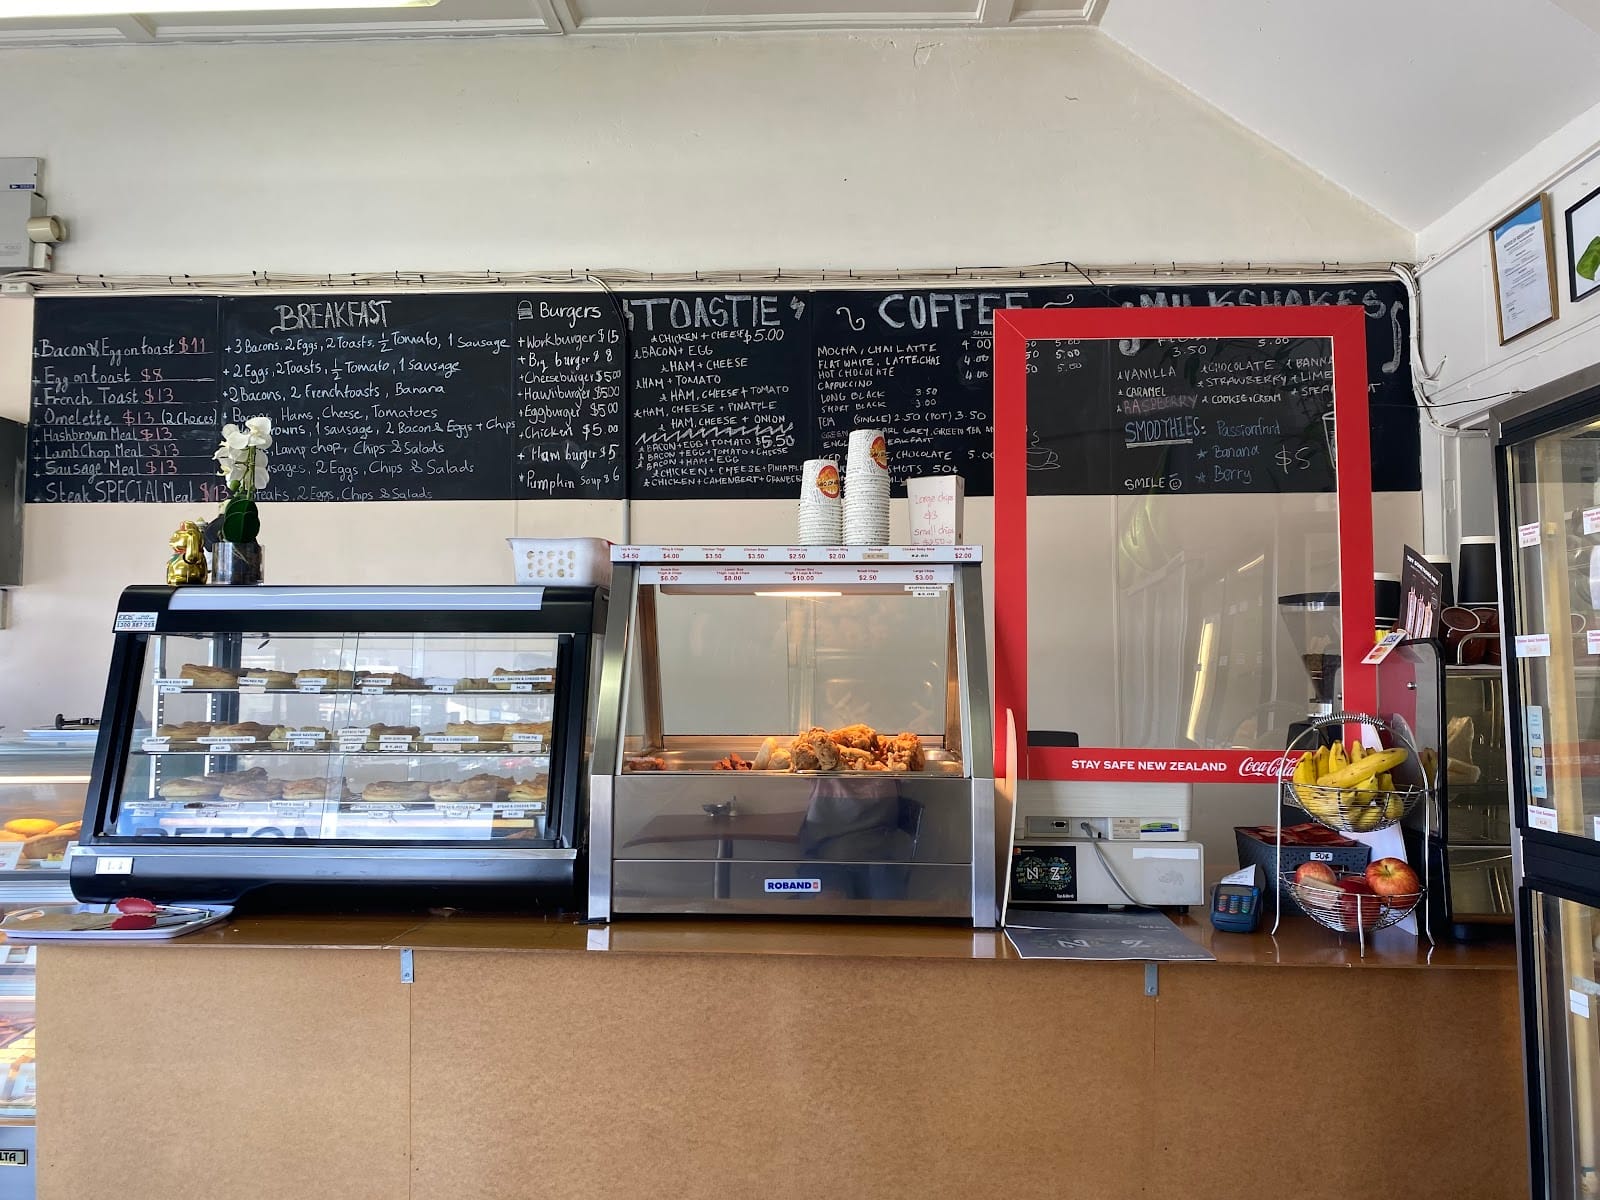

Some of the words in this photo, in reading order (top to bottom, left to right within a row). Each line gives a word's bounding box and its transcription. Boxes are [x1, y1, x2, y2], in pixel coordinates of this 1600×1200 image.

[270, 300, 391, 334] BREAKFAST
[540, 301, 601, 328] Burgers
[630, 294, 781, 331] TOASTIE
[234, 339, 242, 353] 3
[285, 338, 295, 350] 2
[326, 338, 335, 348] 2
[658, 332, 698, 344] CHICKEN
[102, 337, 121, 366] Egg
[179, 336, 206, 354] $11
[688, 345, 713, 356] EGG
[555, 351, 590, 370] burger
[670, 360, 695, 373] HAM
[706, 357, 749, 370] CHEESE
[818, 359, 841, 369] FLAT
[233, 364, 243, 377] 2
[818, 370, 835, 379] HOT
[1124, 366, 1176, 381] VANILLA
[44, 366, 68, 392] Egg
[140, 368, 163, 383] $8
[642, 377, 665, 389] HAM
[675, 374, 721, 386] TOMATO
[43, 387, 92, 405] French
[97, 387, 138, 404] Toast
[144, 387, 174, 404] $13
[290, 386, 301, 399] 2
[395, 382, 445, 396] Banana
[702, 388, 740, 399] CHEESE
[750, 385, 789, 396] TOMATO
[821, 392, 846, 404] LONG
[851, 391, 885, 400] BLACK
[1126, 386, 1167, 397] CARAMEL
[371, 404, 438, 419] Tomatoes
[671, 403, 715, 414] CHEESE
[821, 404, 850, 413] SHORT
[856, 401, 887, 410] BLACK
[44, 408, 112, 425] Omelette
[122, 409, 154, 426] $13
[525, 404, 580, 426] Eggburger
[699, 416, 737, 426] CHEESE
[754, 414, 785, 424] ONION
[111, 427, 137, 441] Meal
[140, 427, 172, 441] $13
[385, 422, 394, 434] 2
[446, 419, 472, 438] Eggs
[486, 416, 516, 434] Chips
[525, 425, 573, 439] Chicken
[115, 443, 143, 457] Meal
[353, 440, 385, 457] Chips
[404, 440, 445, 455] Salads
[683, 441, 704, 449] EGG
[711, 438, 750, 448] TOMATO
[532, 445, 560, 462] Ham
[565, 442, 597, 469] burger
[717, 456, 739, 464] EGG
[1214, 445, 1260, 459] Banana
[1275, 445, 1311, 474] $5
[45, 460, 102, 484] Sausage
[110, 459, 140, 475] Meal
[145, 459, 177, 475] $13
[316, 461, 327, 474] 2
[369, 460, 402, 478] Chips
[427, 459, 475, 475] Salads
[660, 466, 707, 478] CHICKEN
[718, 465, 761, 476] CHEESE
[1214, 465, 1252, 484] Berry
[527, 470, 575, 495] Pumpkin
[651, 477, 696, 487] CHICKEN
[1124, 478, 1165, 491] SMILE
[46, 480, 89, 503] Steak
[162, 480, 193, 503] Meal
[342, 487, 373, 501] Chips
[1071, 759, 1101, 770] STAY
[1103, 759, 1135, 770] SAFE
[1137, 760, 1168, 771] NEW
[1169, 761, 1228, 772] ZEALAND
[767, 881, 812, 890] ROBAND
